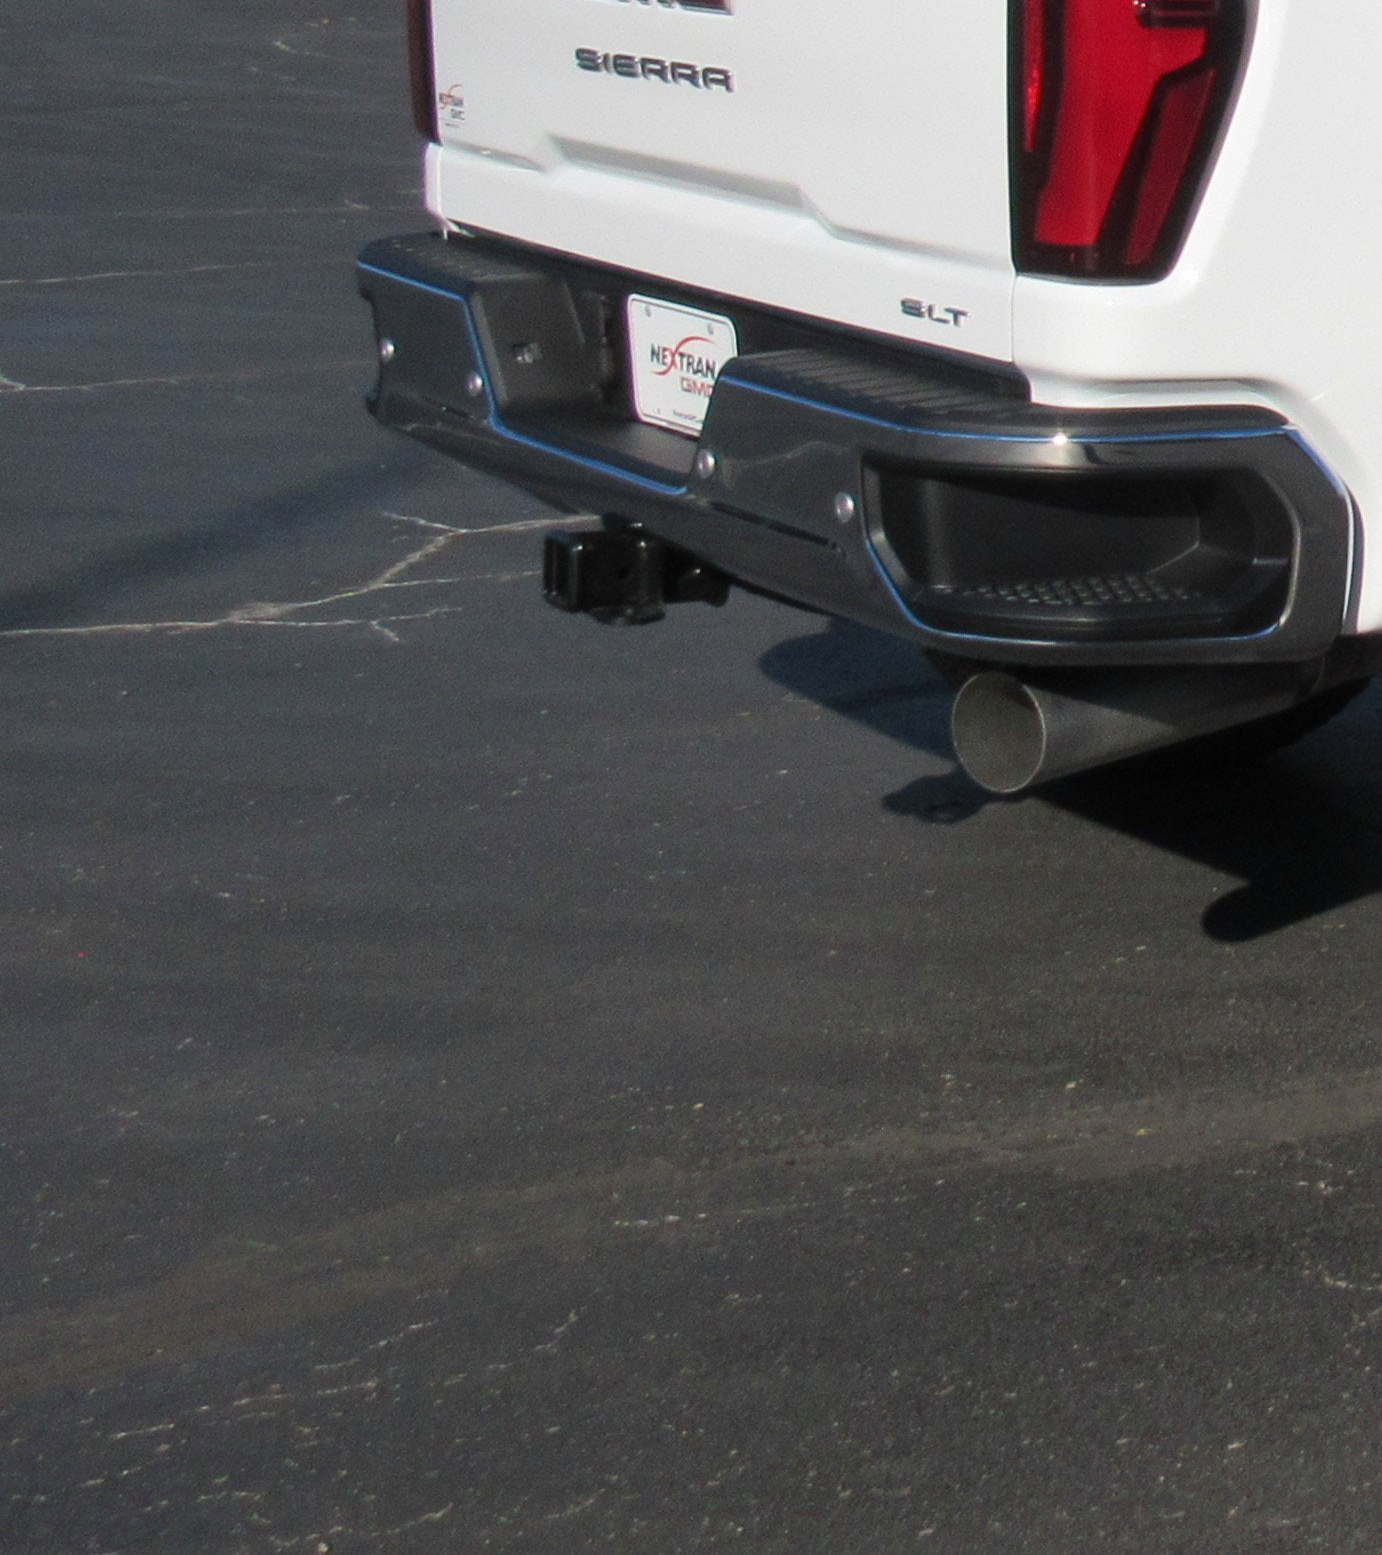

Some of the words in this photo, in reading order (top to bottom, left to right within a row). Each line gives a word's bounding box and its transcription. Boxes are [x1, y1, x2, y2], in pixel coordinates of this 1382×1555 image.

[575, 48, 735, 93] SIERRA
[900, 298, 970, 327] SLT
[650, 343, 717, 380] NEXTRAN
